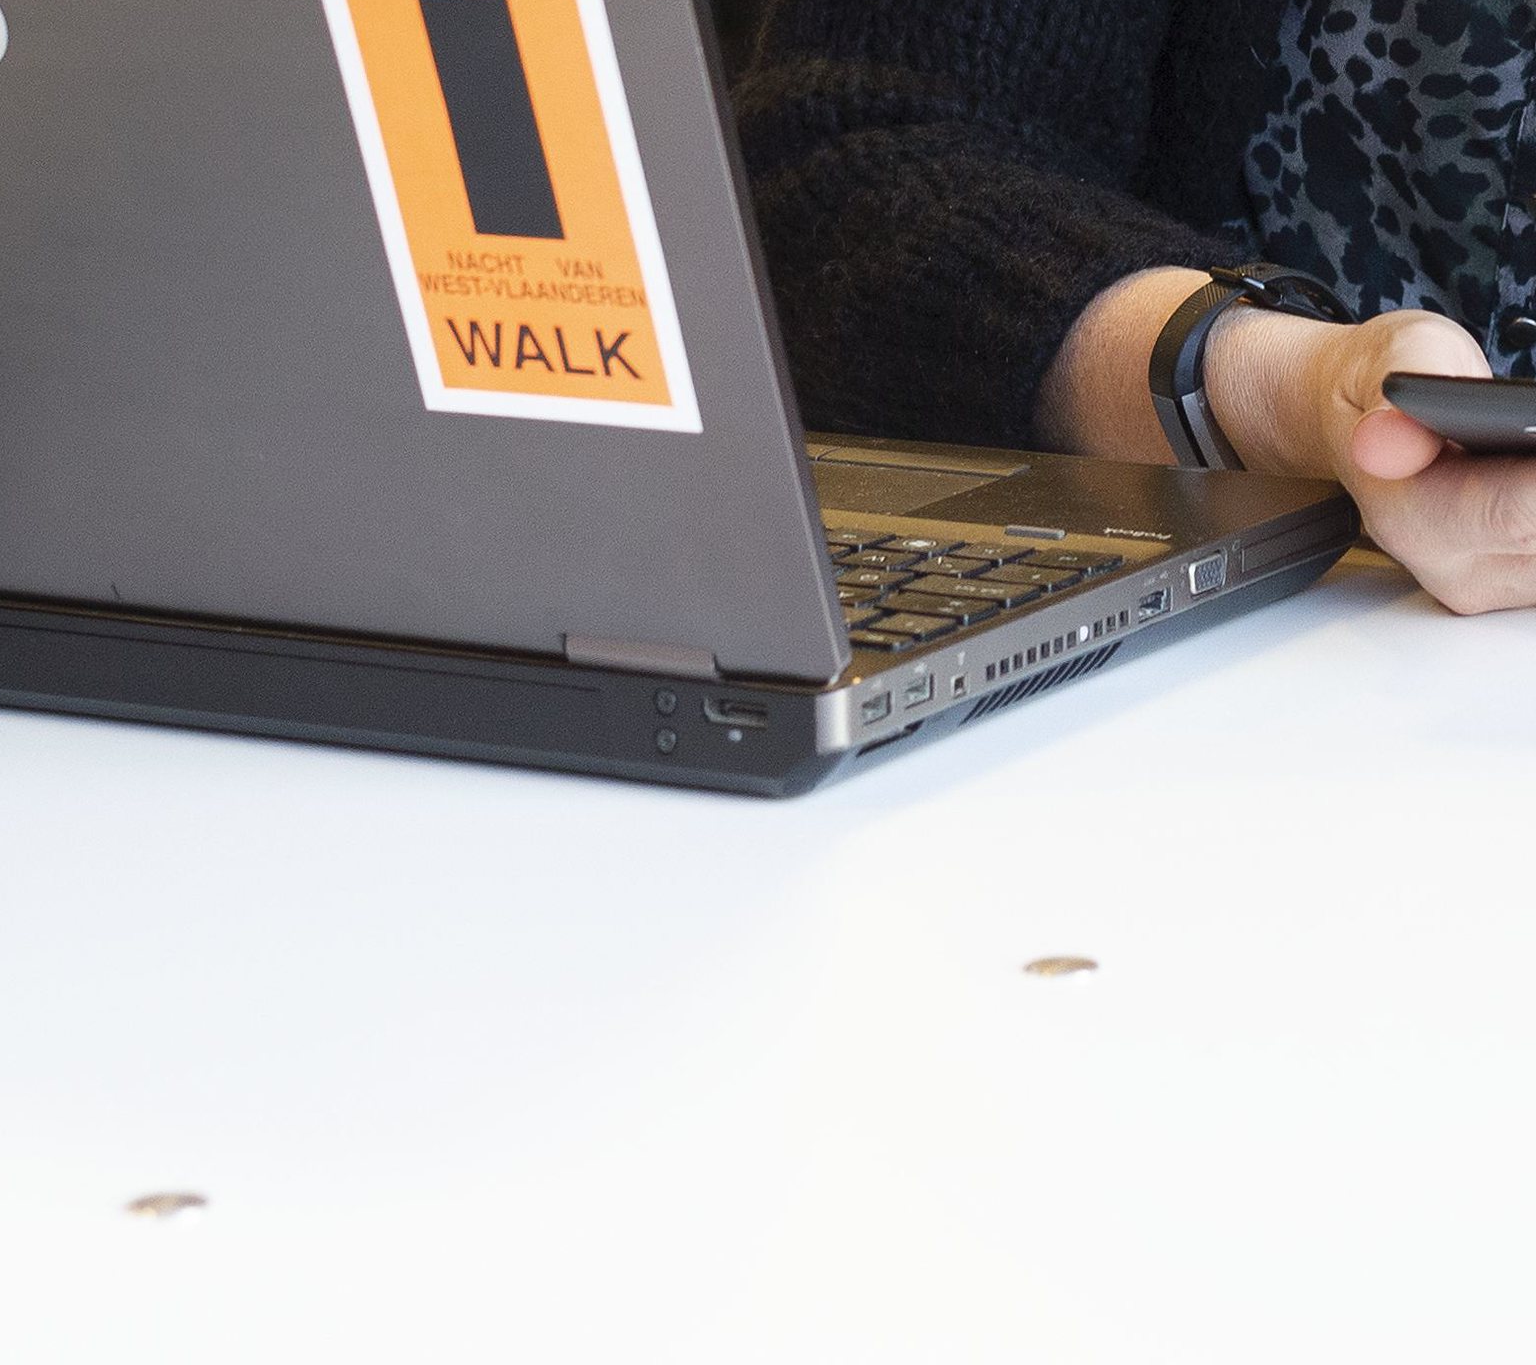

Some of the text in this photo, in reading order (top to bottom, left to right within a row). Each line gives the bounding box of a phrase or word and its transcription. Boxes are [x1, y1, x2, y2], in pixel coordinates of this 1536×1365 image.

[446, 250, 605, 279] NACHT VAN
[418, 273, 647, 307] WEST-VLAANDEREN
[446, 318, 641, 380] WALK
